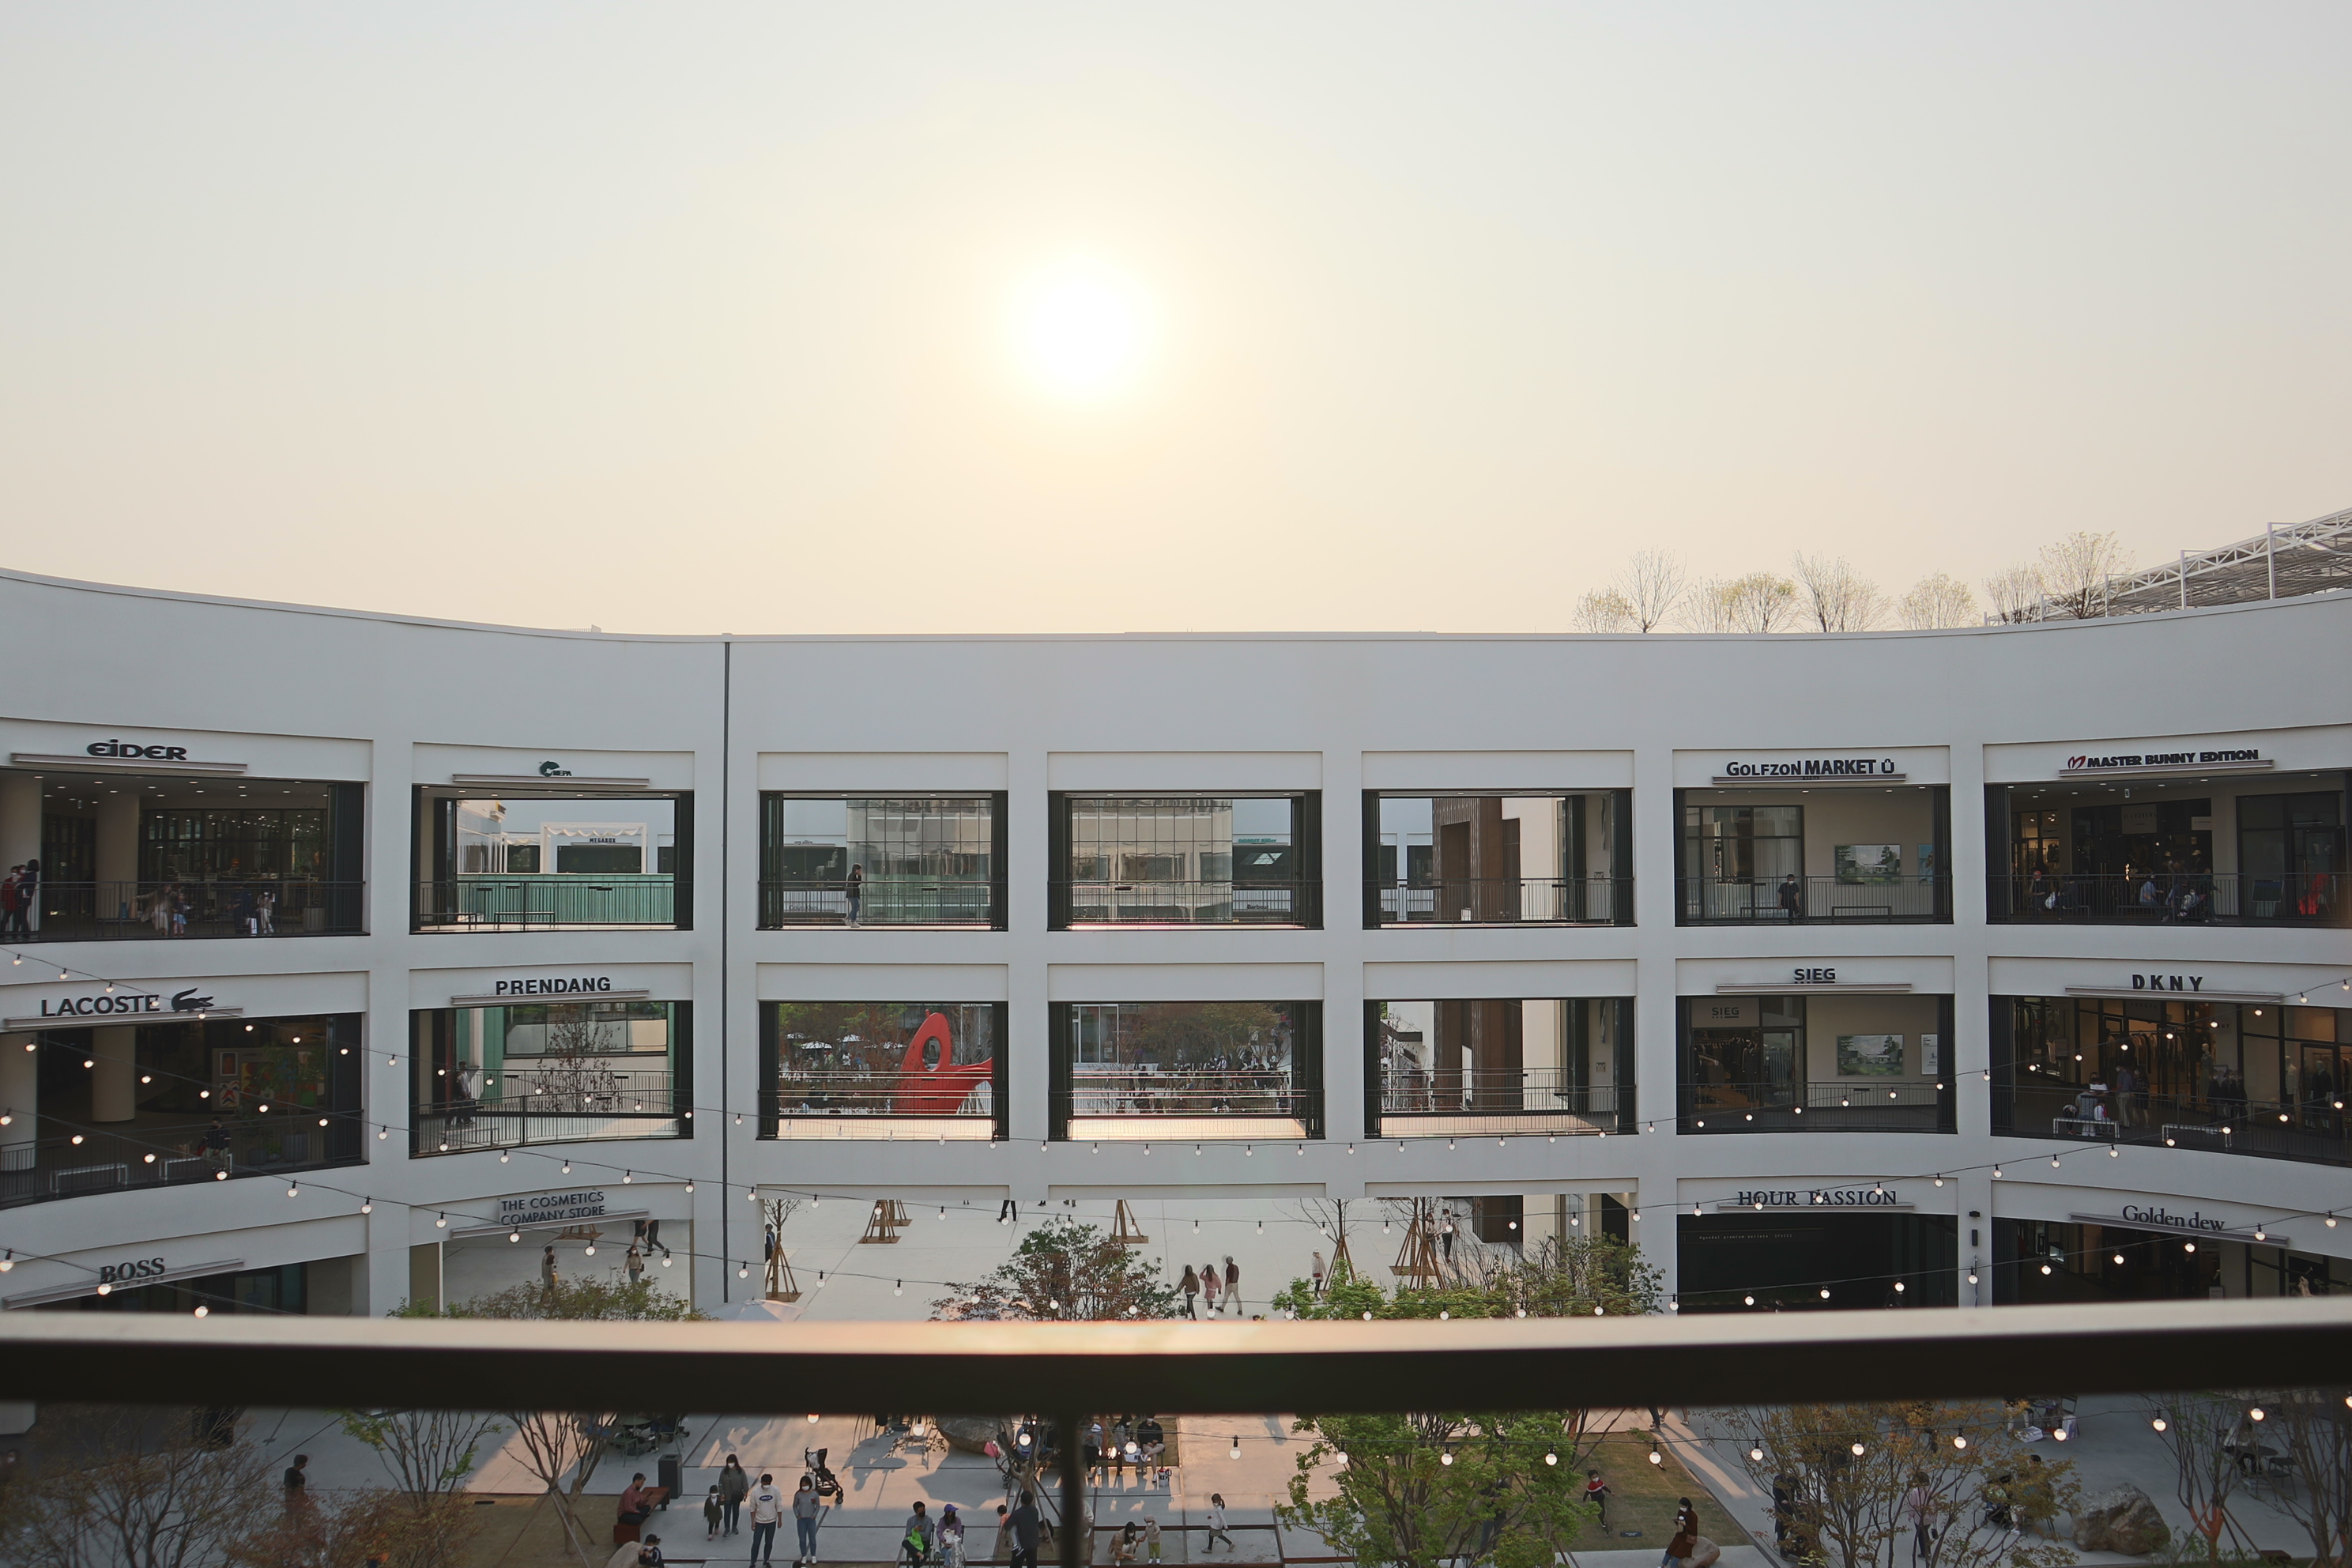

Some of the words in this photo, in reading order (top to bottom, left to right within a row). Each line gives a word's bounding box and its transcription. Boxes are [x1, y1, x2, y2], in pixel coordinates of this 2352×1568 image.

[2087, 756, 2142, 767] MASTER
[2145, 752, 2196, 765] BUNNY
[2200, 749, 2258, 762] EDITION
[1805, 760, 1876, 775] MARKET
[1794, 968, 1836, 981] SIEG
[2132, 974, 2203, 991] DKNY
[496, 977, 610, 995] PRENDANG
[41, 994, 160, 1017] LACOSTE
[1712, 1007, 1739, 1016] SIEG
[501, 1199, 525, 1212] THE
[530, 1191, 604, 1208] COSMETICS
[1738, 1190, 1800, 1206] HOUR
[1808, 1190, 1896, 1206] PASSION
[501, 1209, 564, 1225] COMPANY
[569, 1205, 605, 1219] STORE
[2122, 1204, 2185, 1227] Golden
[2188, 1212, 2225, 1231] dew
[100, 1257, 165, 1283] BOSS
